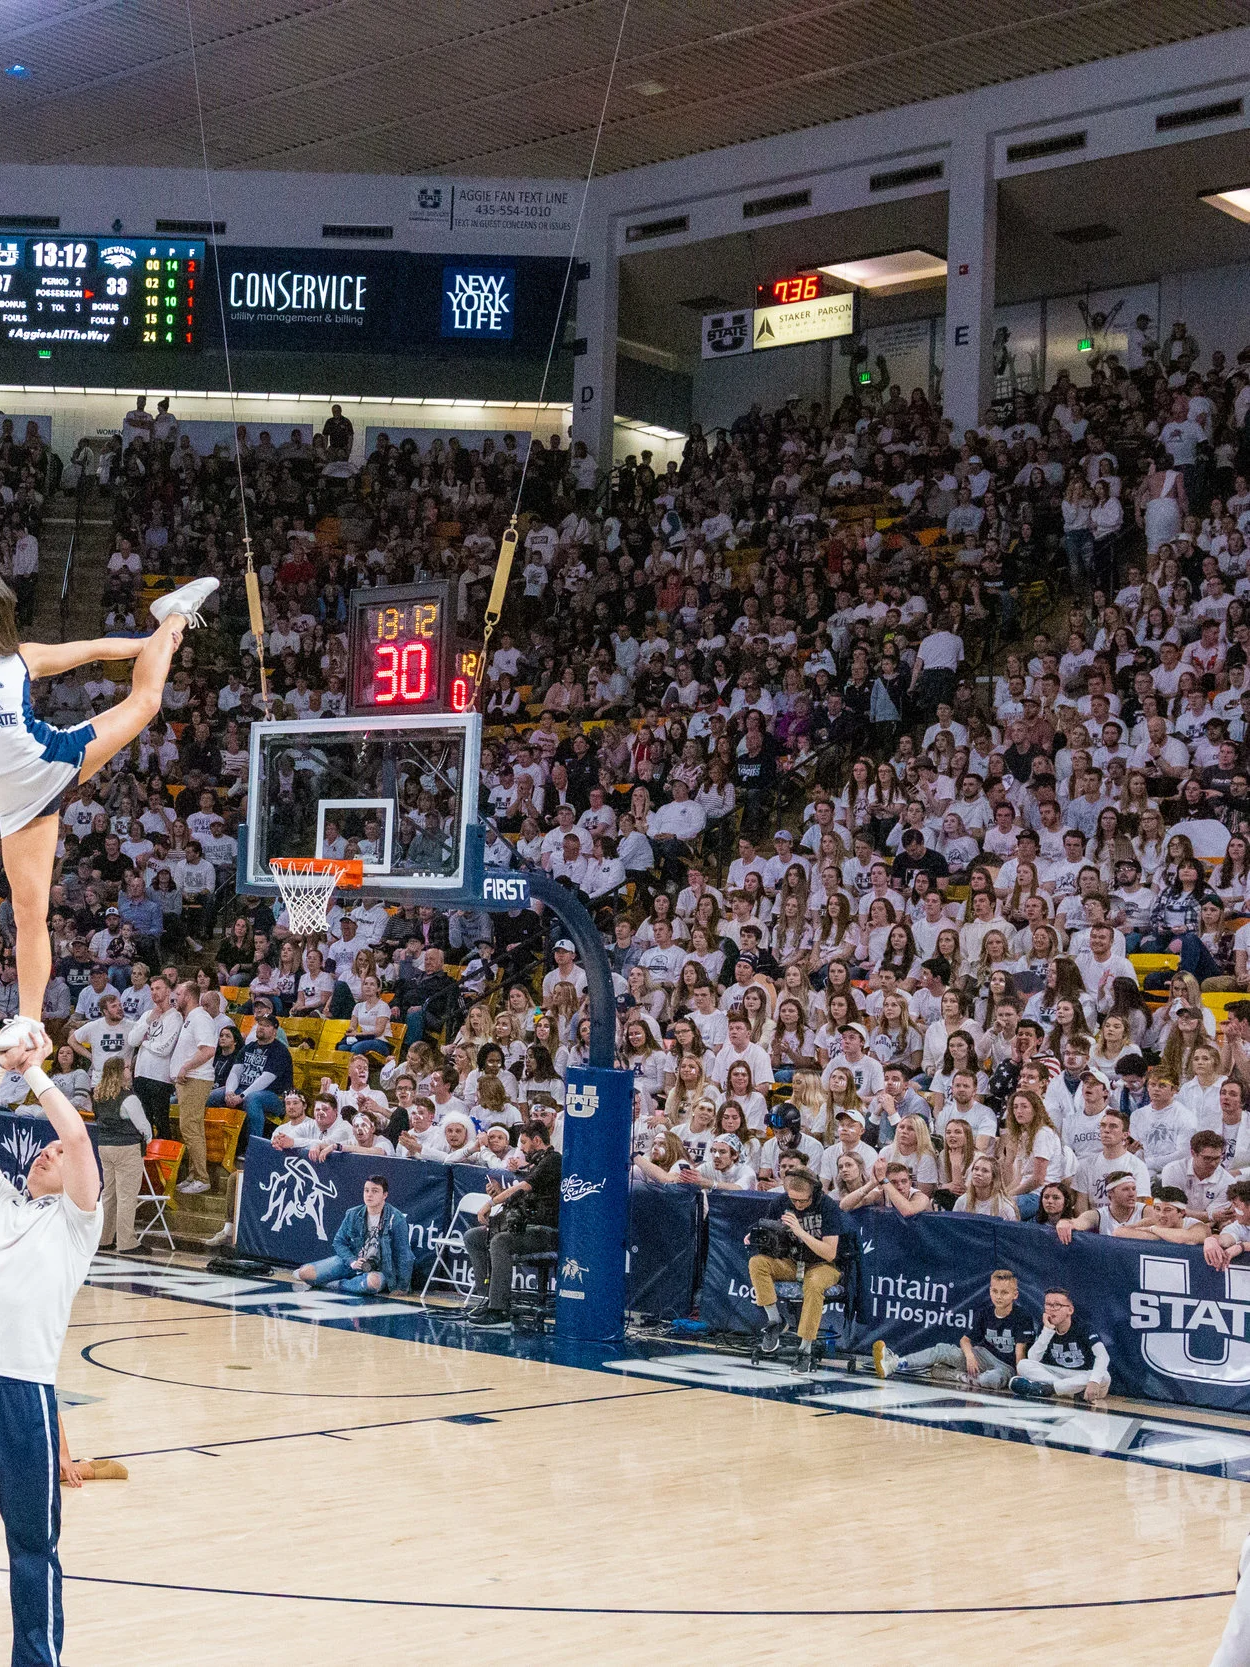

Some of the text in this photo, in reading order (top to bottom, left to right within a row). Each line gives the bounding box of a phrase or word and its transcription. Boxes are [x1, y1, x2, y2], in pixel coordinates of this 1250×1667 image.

[460, 190, 568, 204] AGGIE FAN TEXT LINE
[475, 205, 551, 217] 435-554-1010
[454, 219, 470, 227] TEXT
[33, 242, 88, 268] 13:12
[100, 246, 137, 259] NEVADA
[169, 248, 175, 256] P
[189, 249, 195, 257] F
[146, 260, 195, 272] 00 14 2
[41, 277, 81, 286] PERIOD 2
[106, 277, 128, 296] 33
[145, 278, 194, 290] 02 0 1
[454, 275, 505, 293] NEW
[36, 289, 83, 298] POSSESSION
[230, 271, 367, 311] CONSERVICE
[37, 302, 43, 311] 3
[51, 304, 66, 312] TOL
[75, 303, 81, 312] 3
[91, 303, 119, 311] BONUS
[146, 296, 193, 307] 10 10 1
[446, 291, 510, 313] YORK
[90, 316, 129, 325] FOULS 0
[145, 314, 193, 325] 15 0 1
[230, 312, 363, 325] utility management & billing
[453, 311, 503, 330] LIFE
[779, 303, 852, 323] STAKER PARSON
[8, 329, 110, 342] #AggiesAllTheWay
[143, 332, 192, 343] 24 4 1
[707, 325, 748, 342] STATE
[711, 314, 745, 353] U
[954, 325, 969, 346] E
[581, 386, 594, 403] D
[377, 604, 436, 640] 13:12
[376, 643, 428, 703] 30
[483, 878, 527, 900] FIRST
[100, 1038, 125, 1047] STATE
[686, 1148, 706, 1156] TATE
[799, 1214, 823, 1230] GIES
[728, 1279, 757, 1304] Log
[886, 1302, 973, 1330] Hospital
[1130, 1292, 1250, 1338] STAT
[602, 1354, 1250, 1468] STAT
